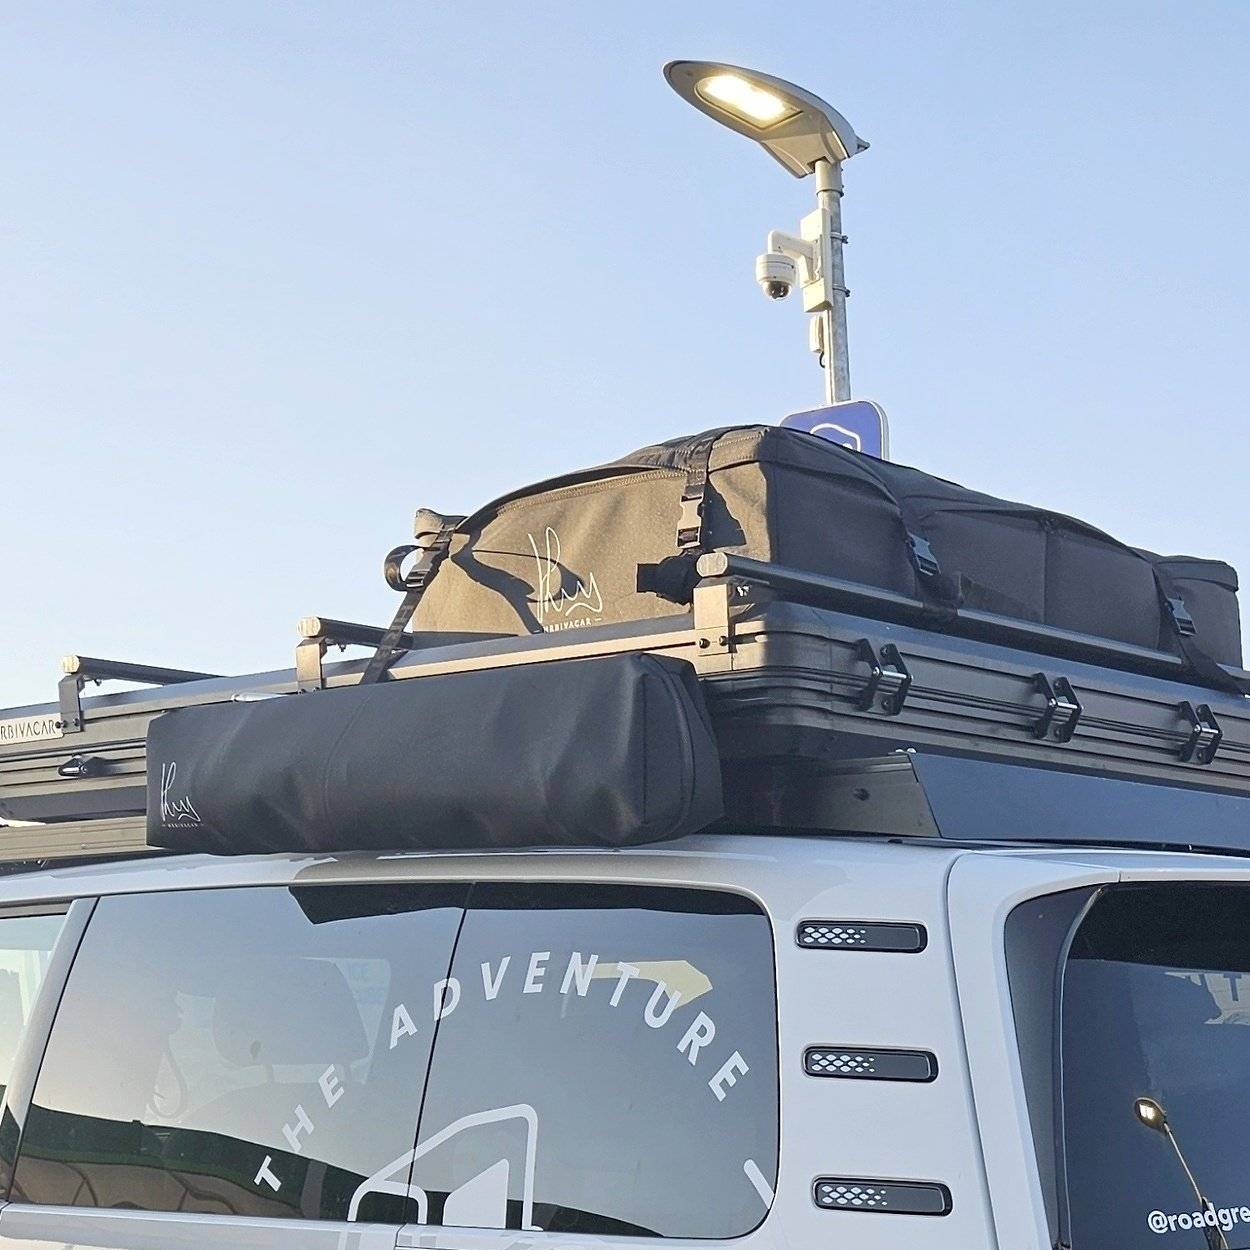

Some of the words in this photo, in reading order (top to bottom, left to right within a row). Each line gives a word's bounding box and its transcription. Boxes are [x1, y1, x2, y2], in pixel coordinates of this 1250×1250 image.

[0, 719, 56, 740] RBIVACAR
[253, 1063, 346, 1192] THE
[389, 951, 750, 1102] ADVENTURE
